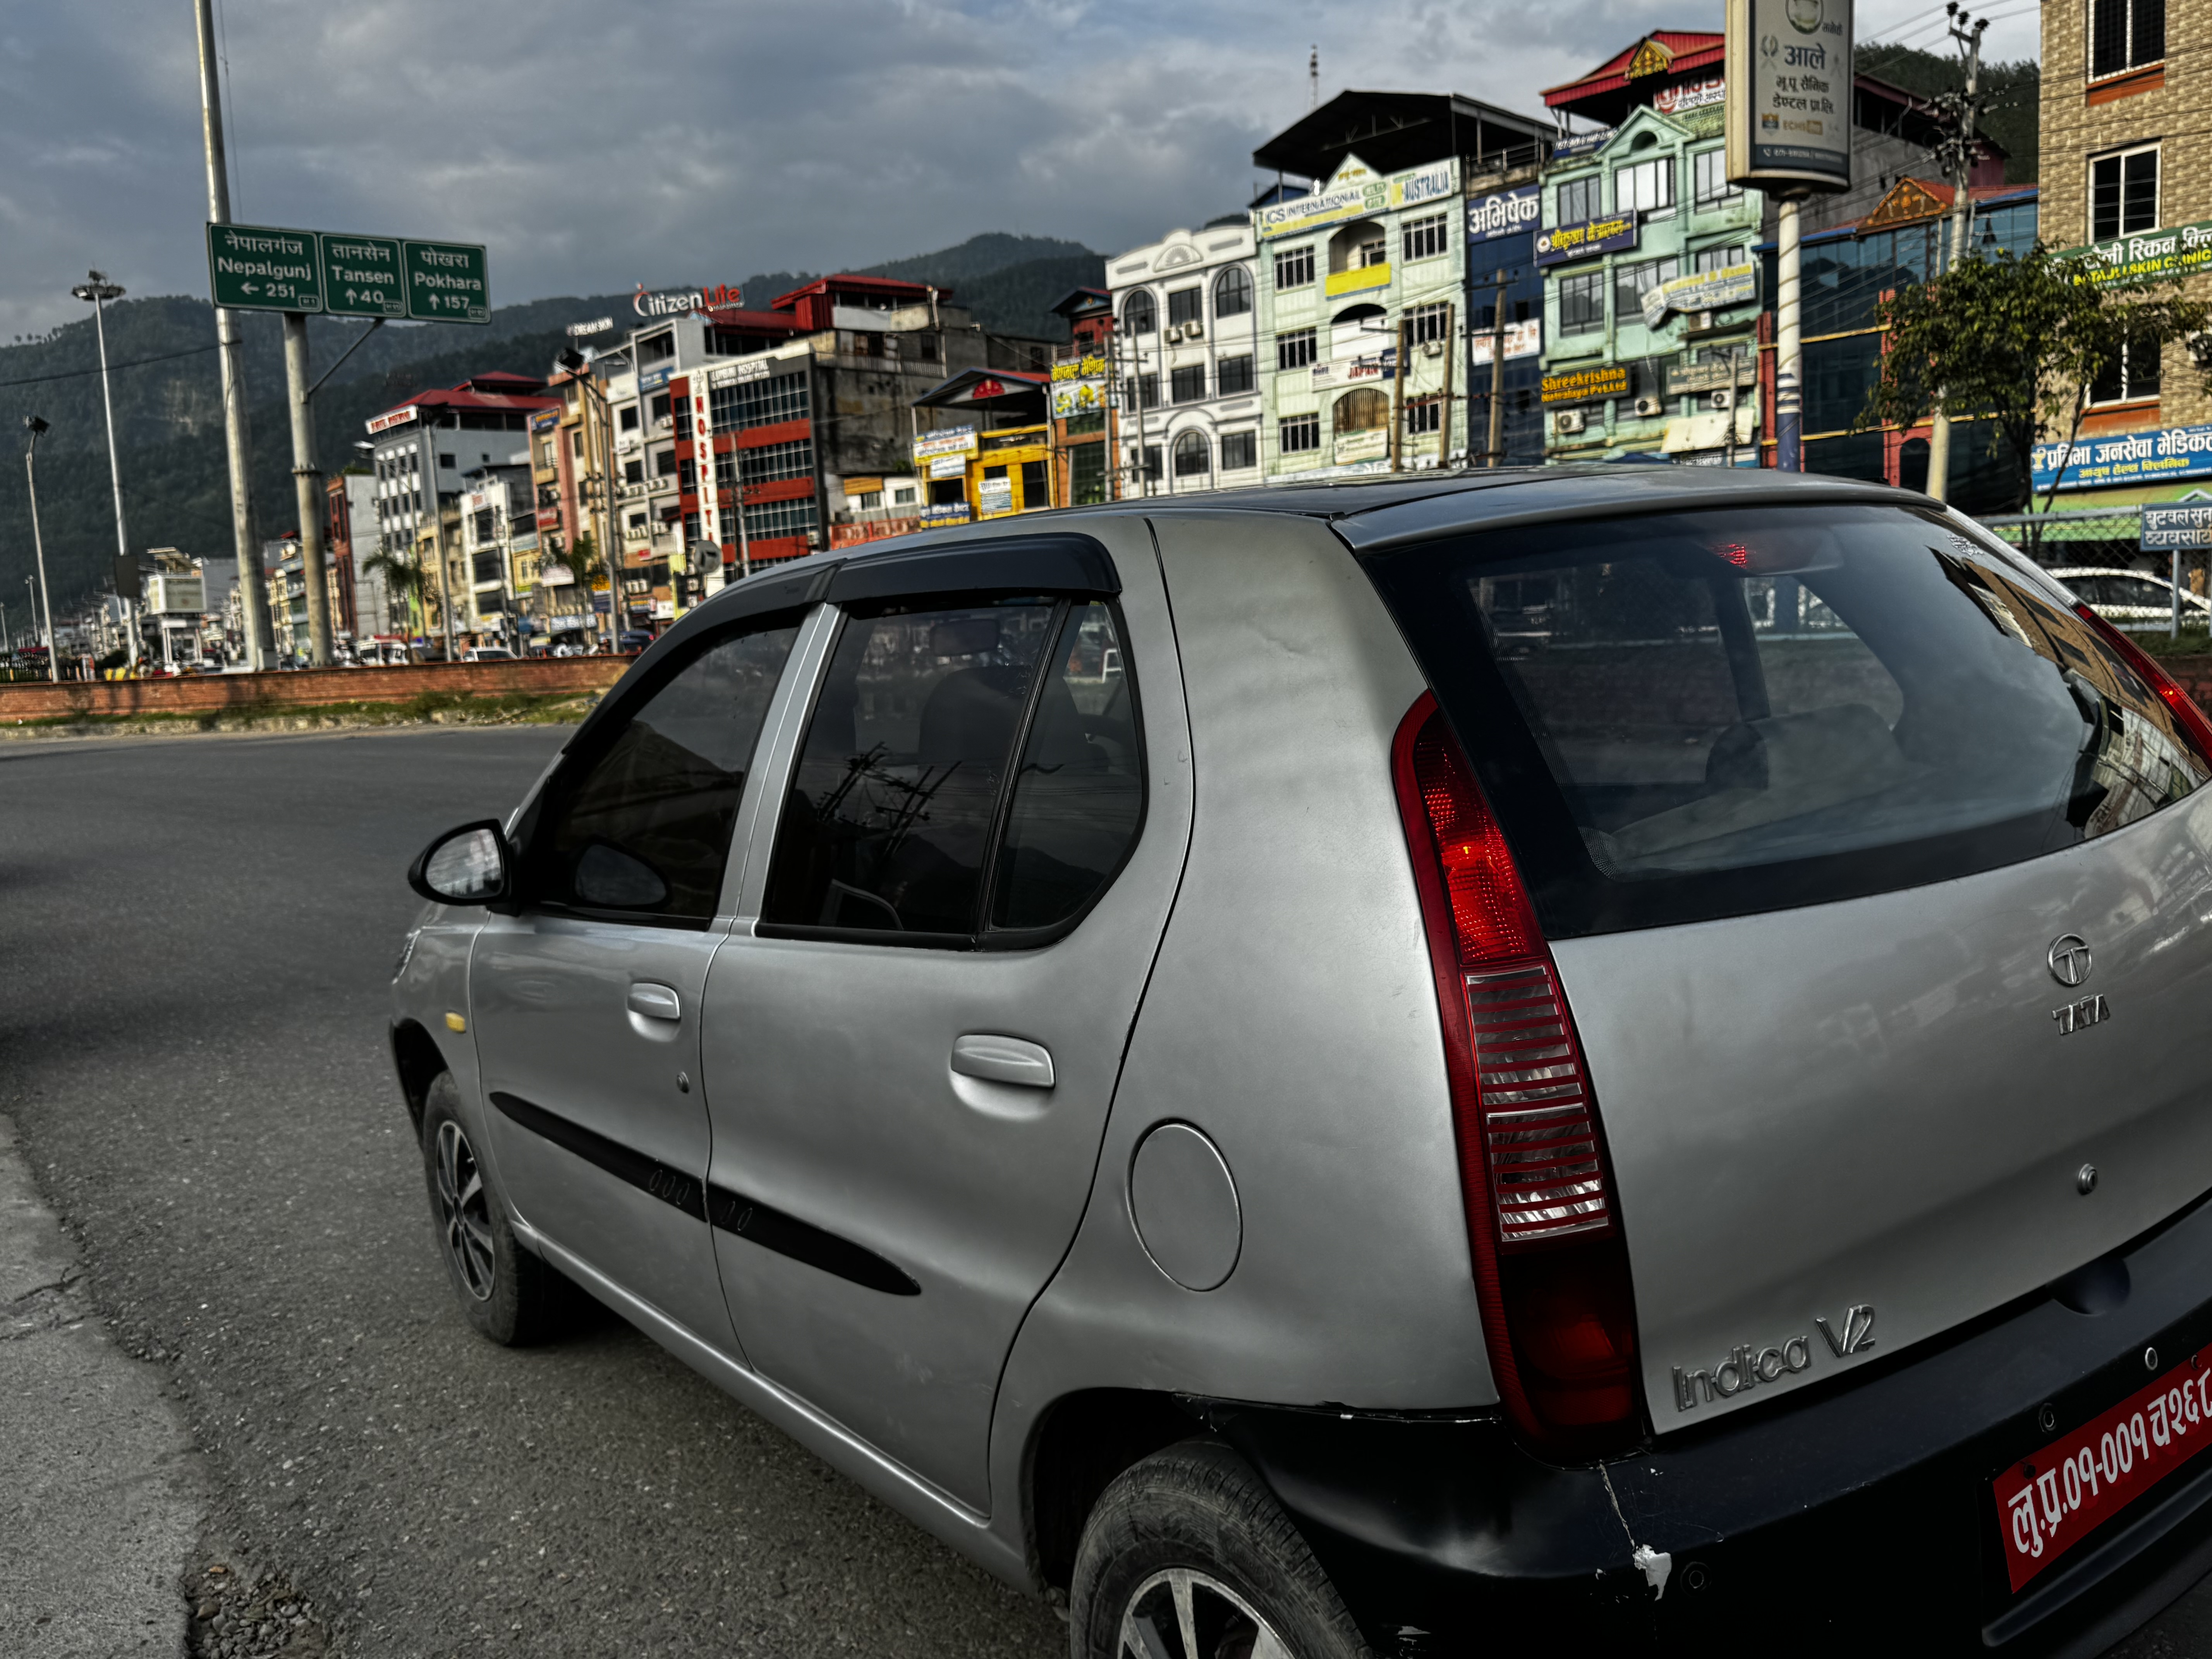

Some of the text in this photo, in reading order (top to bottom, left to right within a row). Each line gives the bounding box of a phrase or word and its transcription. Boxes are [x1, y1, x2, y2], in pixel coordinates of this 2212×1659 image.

[1784, 42, 1826, 70] आले
[1265, 188, 1361, 225] ICS INTERNATIONAL
[1468, 191, 1540, 234] अभिषेक
[331, 241, 391, 262] तानसेन
[420, 246, 469, 269] पोखरा
[2130, 258, 2161, 275] SKIN
[2164, 249, 2212, 269] CINIC
[218, 256, 312, 282] Nepalgunj
[331, 265, 395, 285] Tansen
[414, 271, 482, 291] Pokhara
[266, 283, 295, 299] 251
[360, 290, 384, 304] 40
[444, 295, 469, 310] 157
[633, 291, 703, 316] Citizen
[703, 283, 740, 307] Life
[1541, 368, 1626, 392] Shreekrishna
[2095, 434, 2154, 463] जनसेवा
[2145, 508, 2189, 531] बुटवल
[2052, 994, 2111, 1036] TATA
[1673, 1304, 1875, 1412] Indica V2
